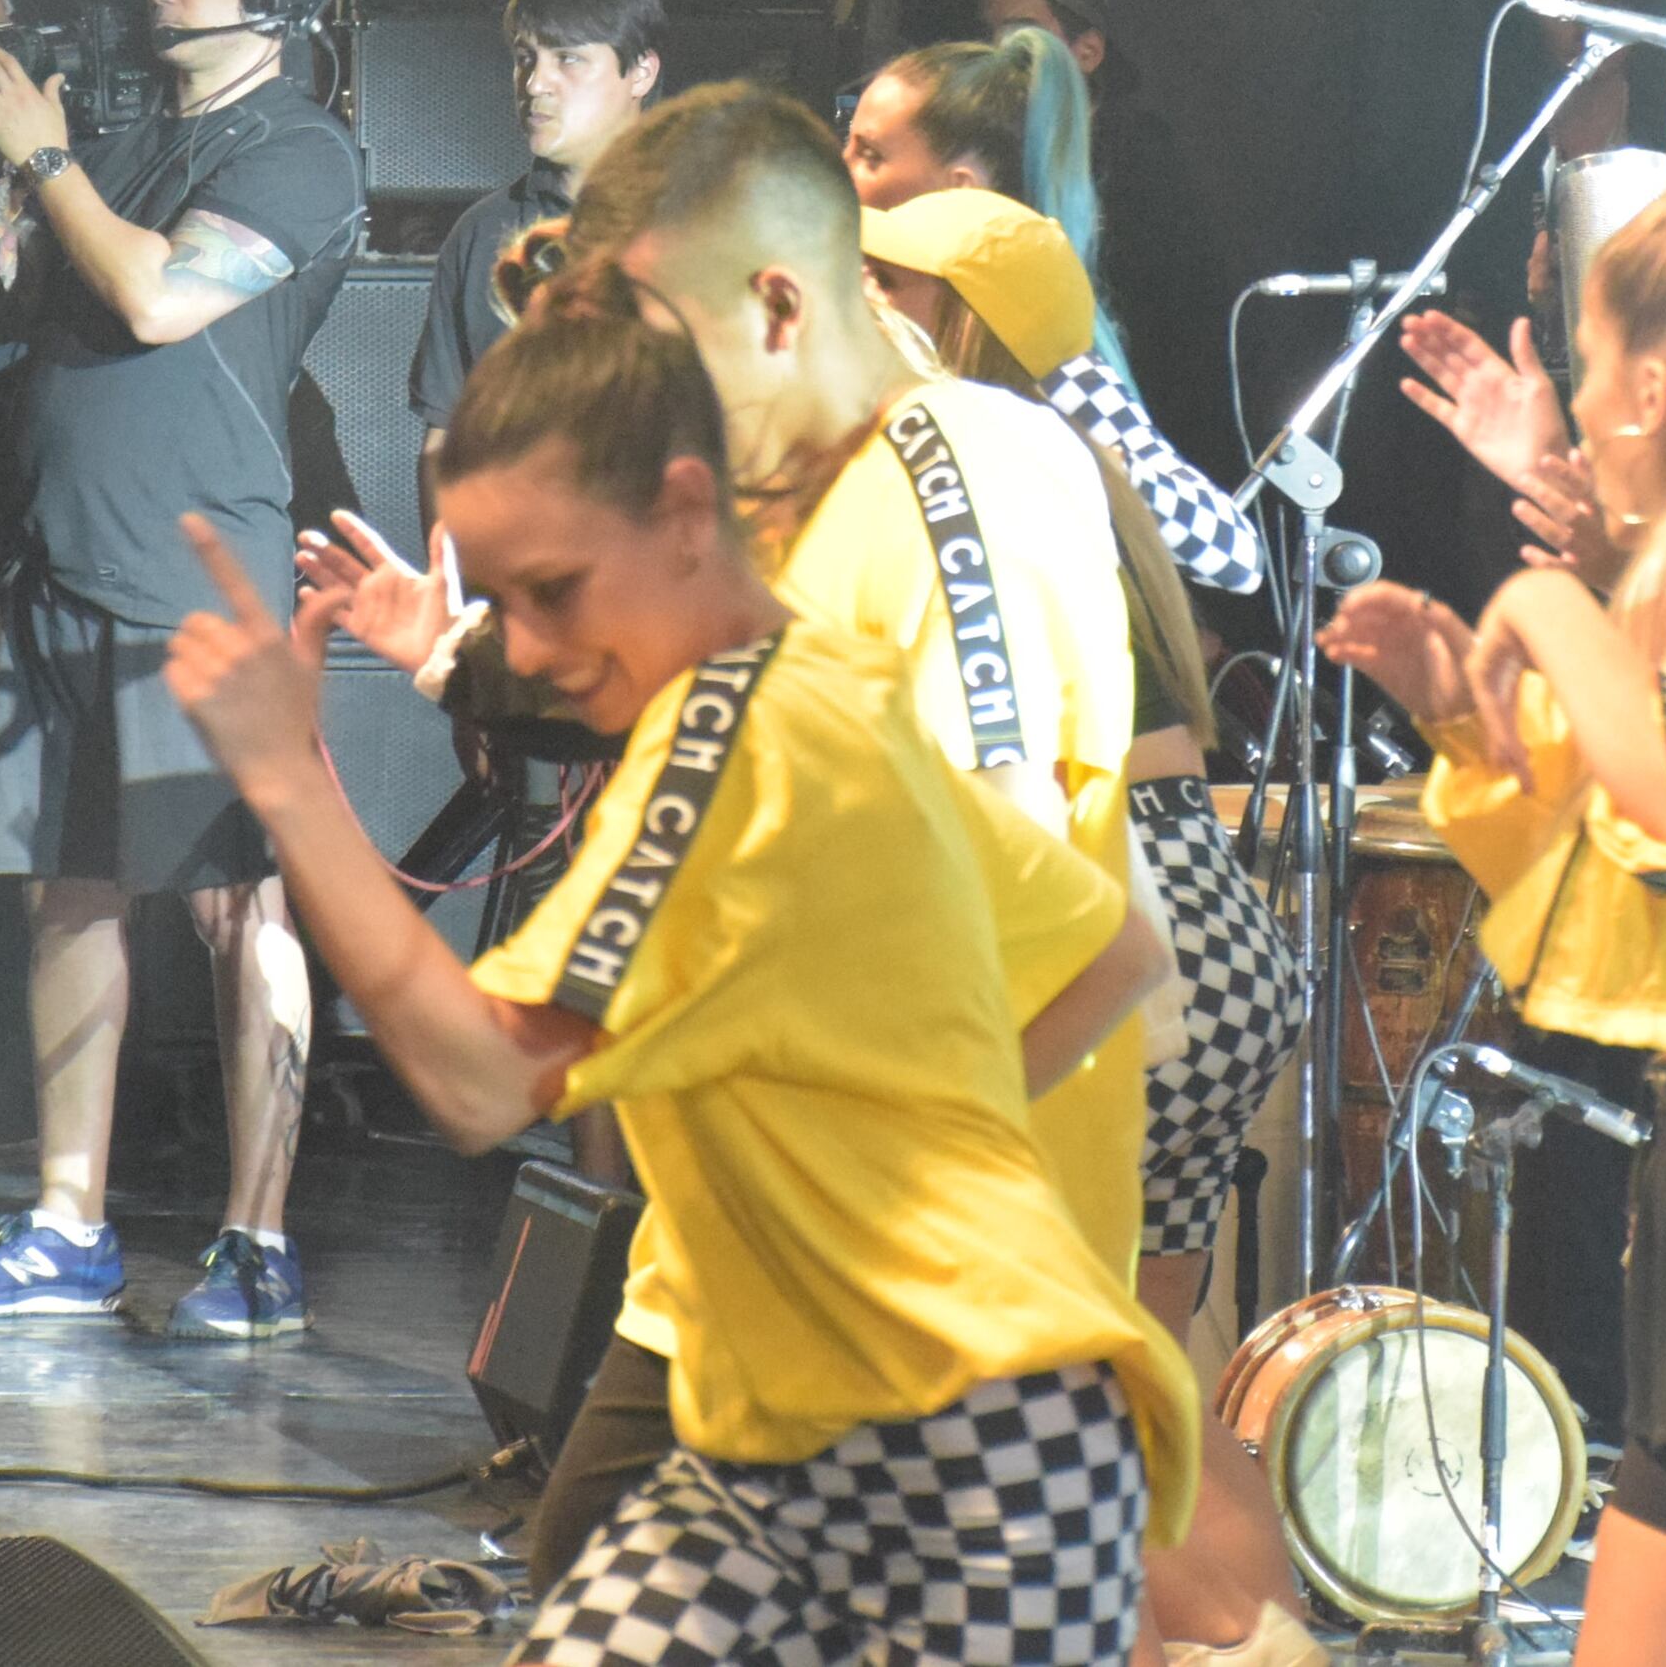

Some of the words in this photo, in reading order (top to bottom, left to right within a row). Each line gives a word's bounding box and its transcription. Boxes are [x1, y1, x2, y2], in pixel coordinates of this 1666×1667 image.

[889, 407, 971, 523] CATCH
[940, 537, 1016, 725] CATCH
[567, 793, 697, 987] CATCH
